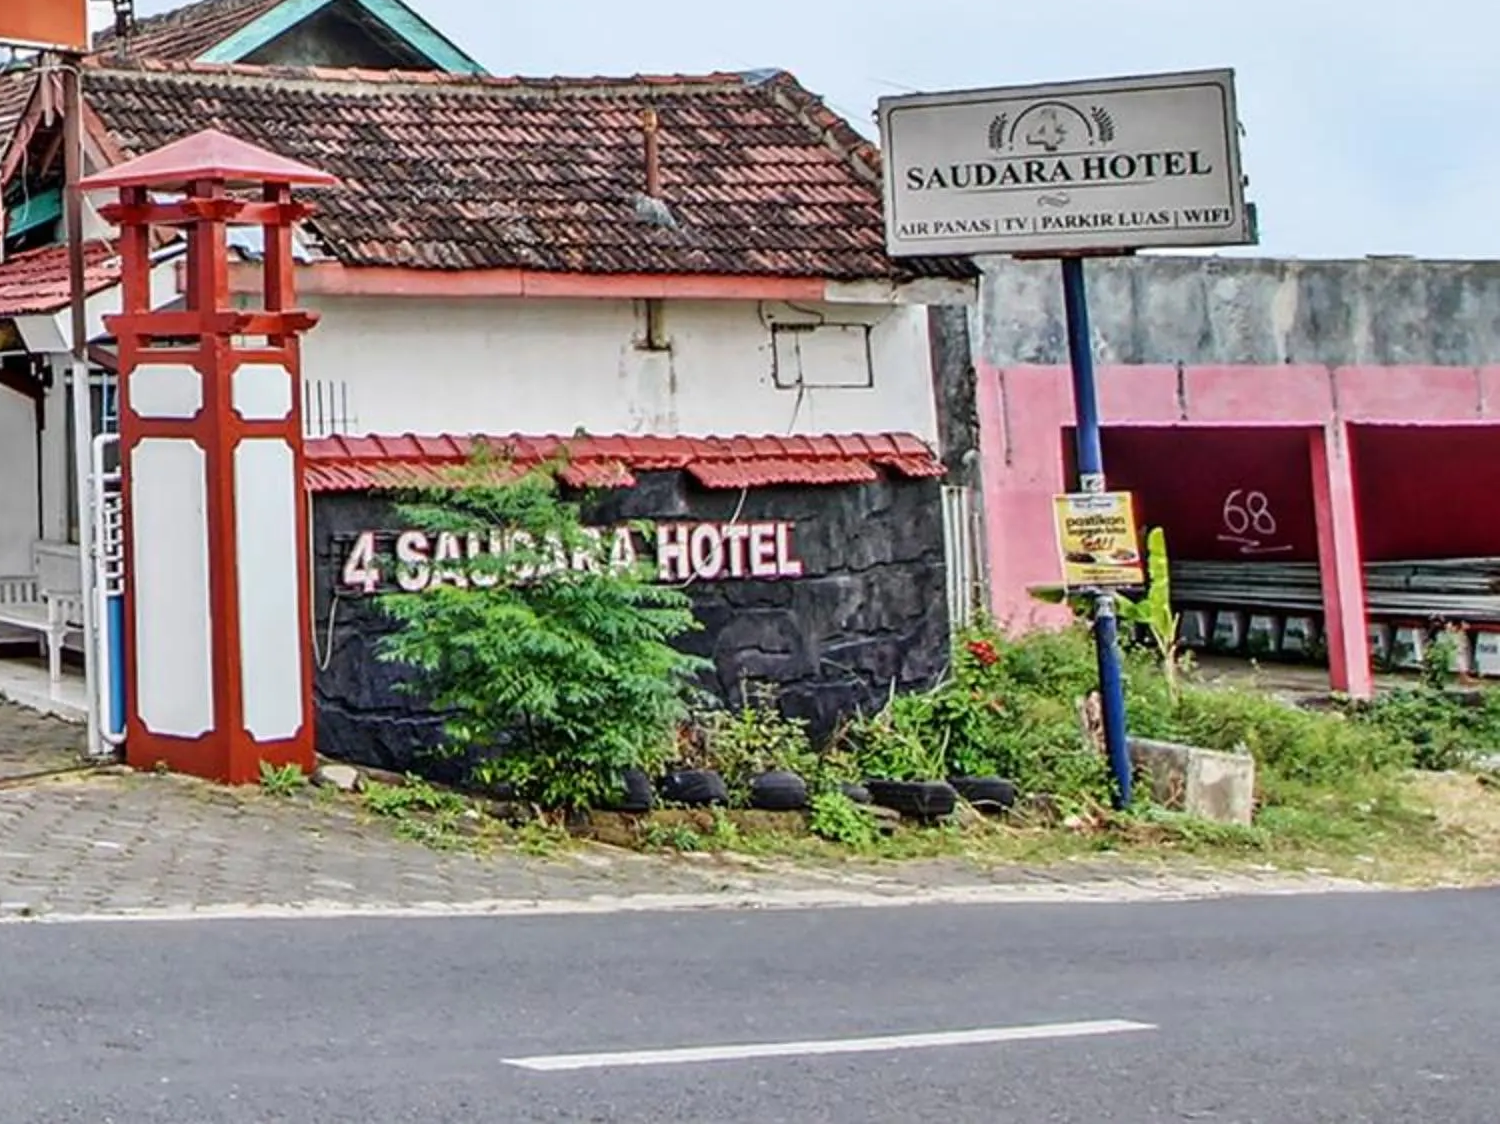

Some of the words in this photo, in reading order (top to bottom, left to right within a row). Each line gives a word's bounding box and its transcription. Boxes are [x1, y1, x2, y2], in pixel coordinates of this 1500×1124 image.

[906, 158, 1071, 191] SAUDARA
[1083, 150, 1213, 182] HOTEL
[900, 223, 930, 236] AIR
[933, 218, 992, 235] PANAS
[1004, 217, 1029, 231] TV
[1041, 213, 1116, 230] PARKIR
[1118, 210, 1171, 227] LUAS
[1184, 207, 1232, 224] WIFI
[1223, 489, 1276, 534] 68
[342, 530, 380, 594] 4
[657, 521, 803, 582] HOTEL
